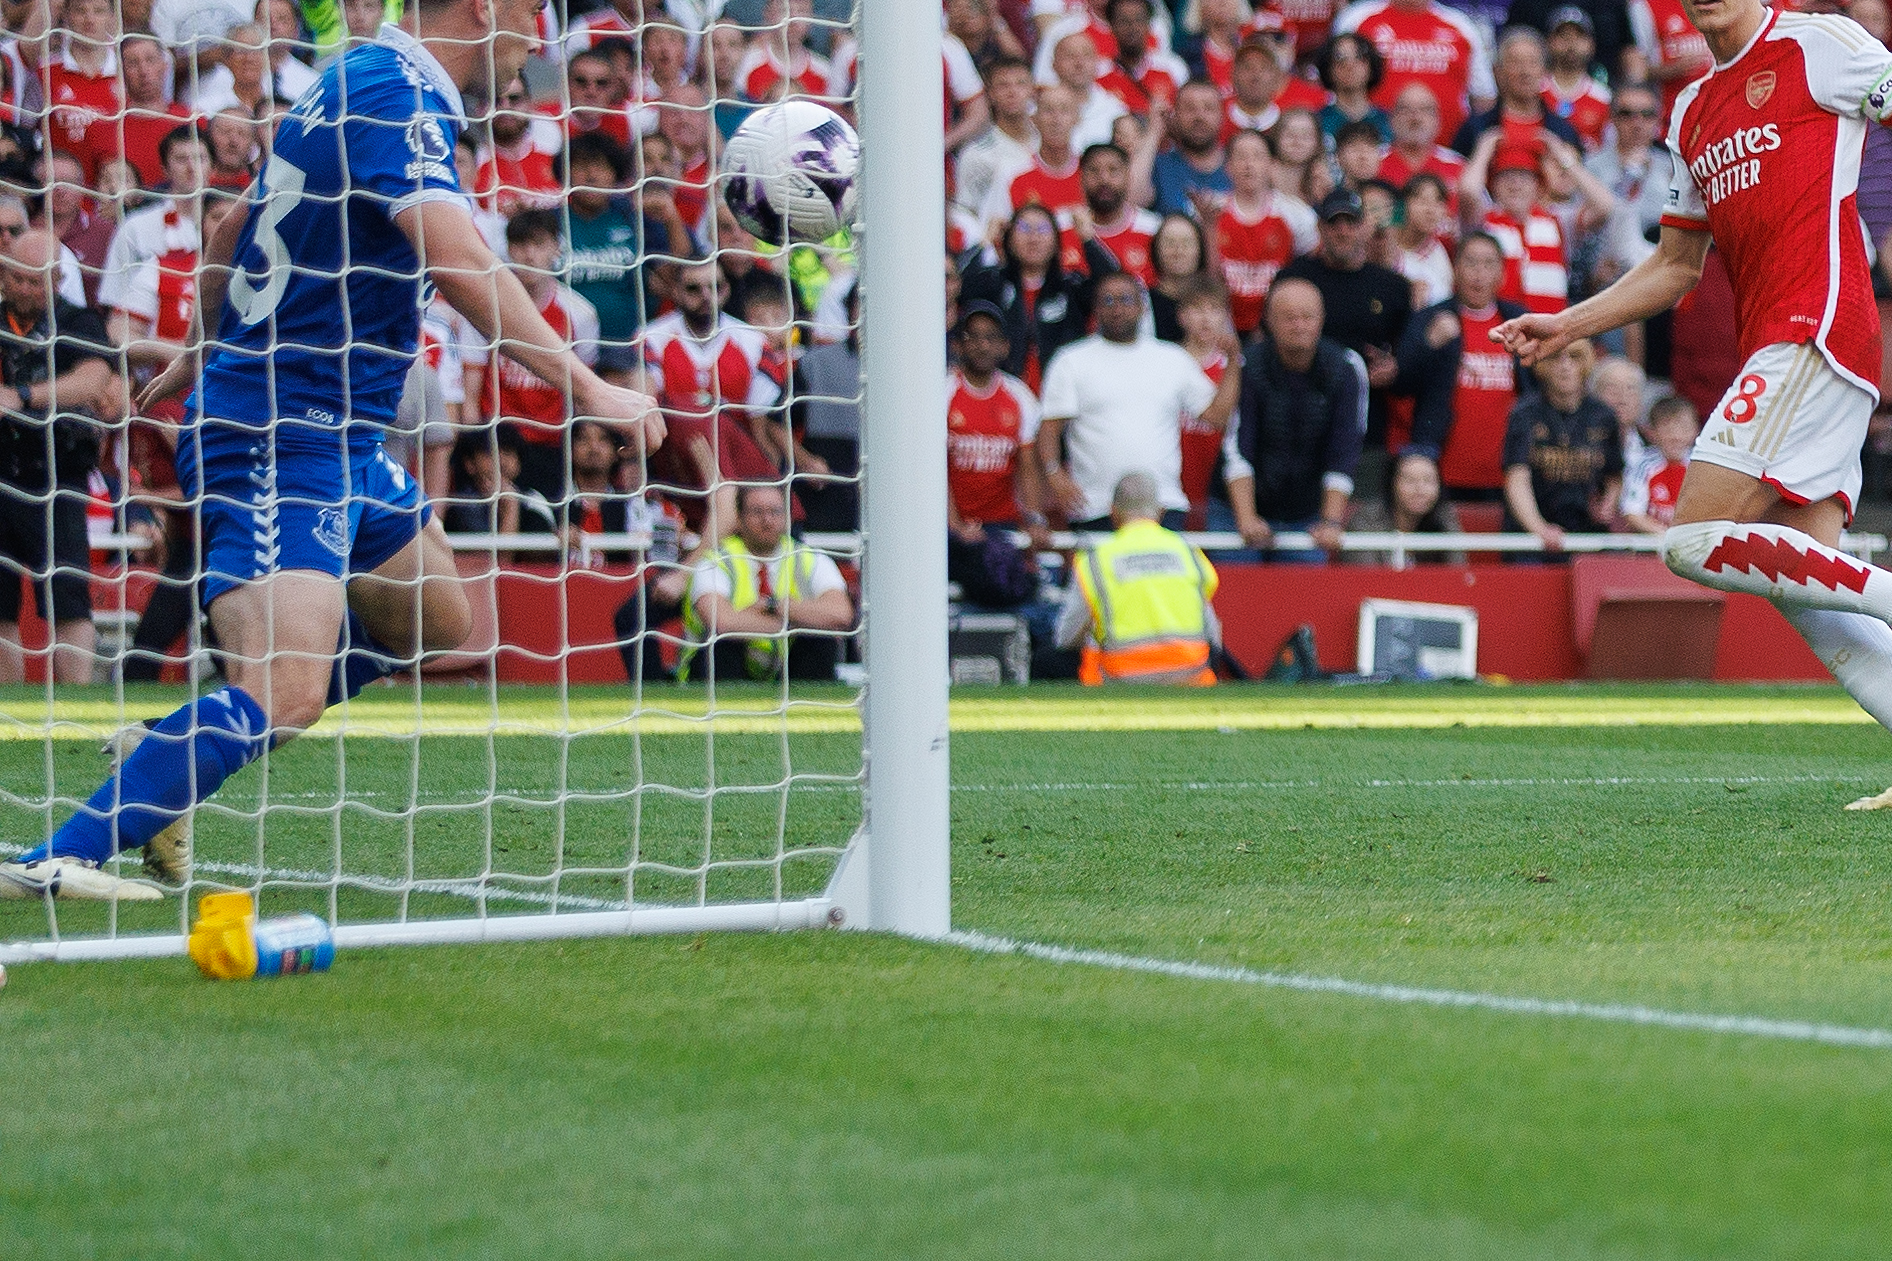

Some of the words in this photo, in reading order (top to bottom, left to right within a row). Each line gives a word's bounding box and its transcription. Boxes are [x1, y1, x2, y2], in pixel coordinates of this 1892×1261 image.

[1711, 158, 1761, 205] BETTER
[228, 153, 307, 326] 3
[1723, 373, 1767, 424] 8
